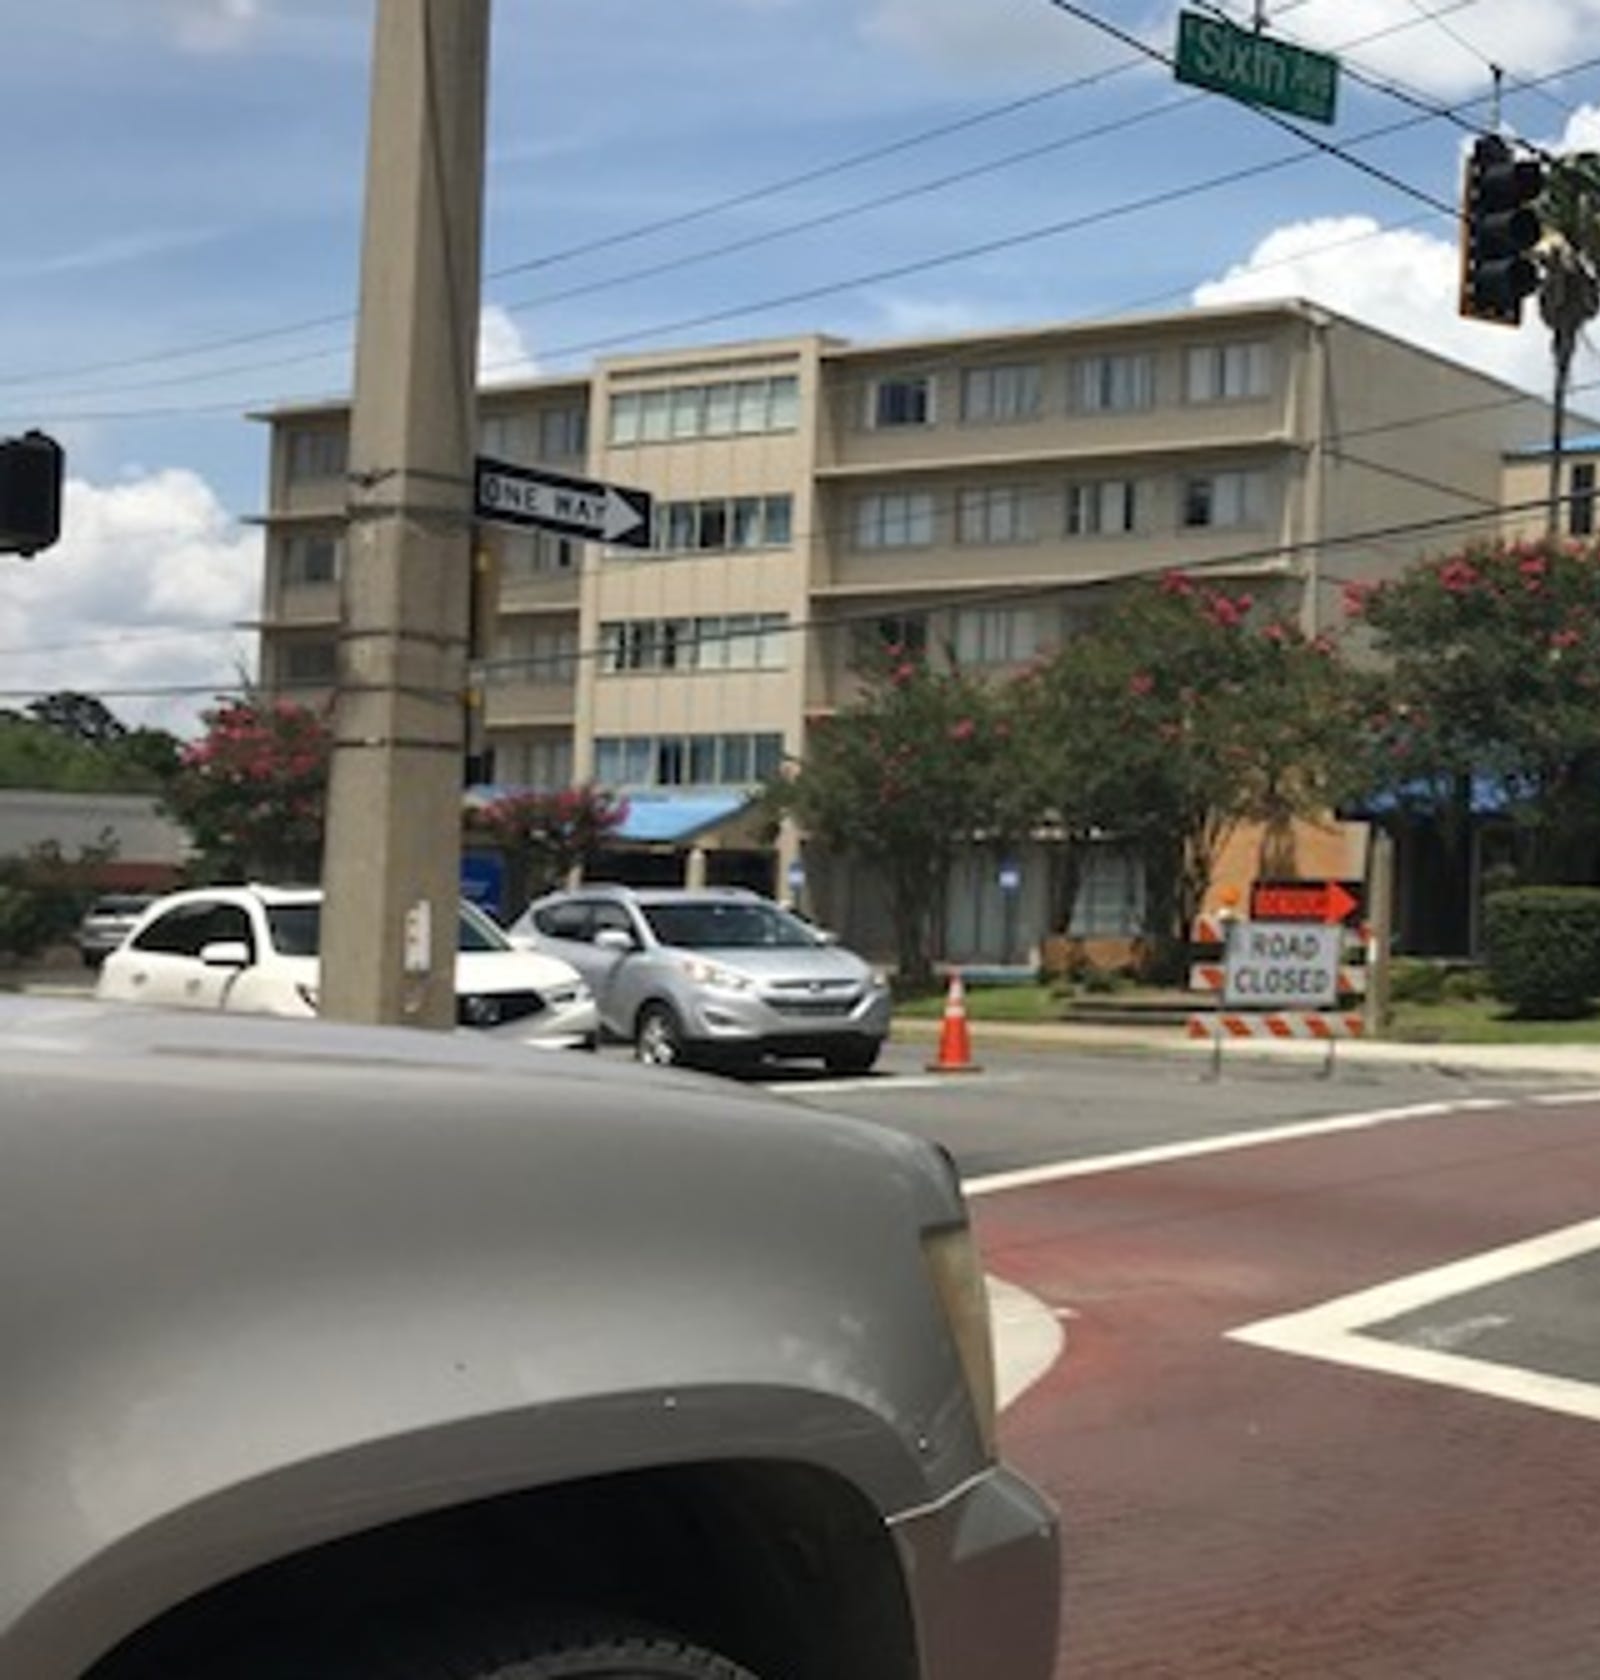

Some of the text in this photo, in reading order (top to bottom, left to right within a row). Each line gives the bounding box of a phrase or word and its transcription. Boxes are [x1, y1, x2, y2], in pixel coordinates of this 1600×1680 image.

[1194, 23, 1286, 93] Sixth
[484, 477, 609, 521] ONE WAY
[1253, 932, 1320, 960] ROAD
[1234, 967, 1330, 995] CLOSED
